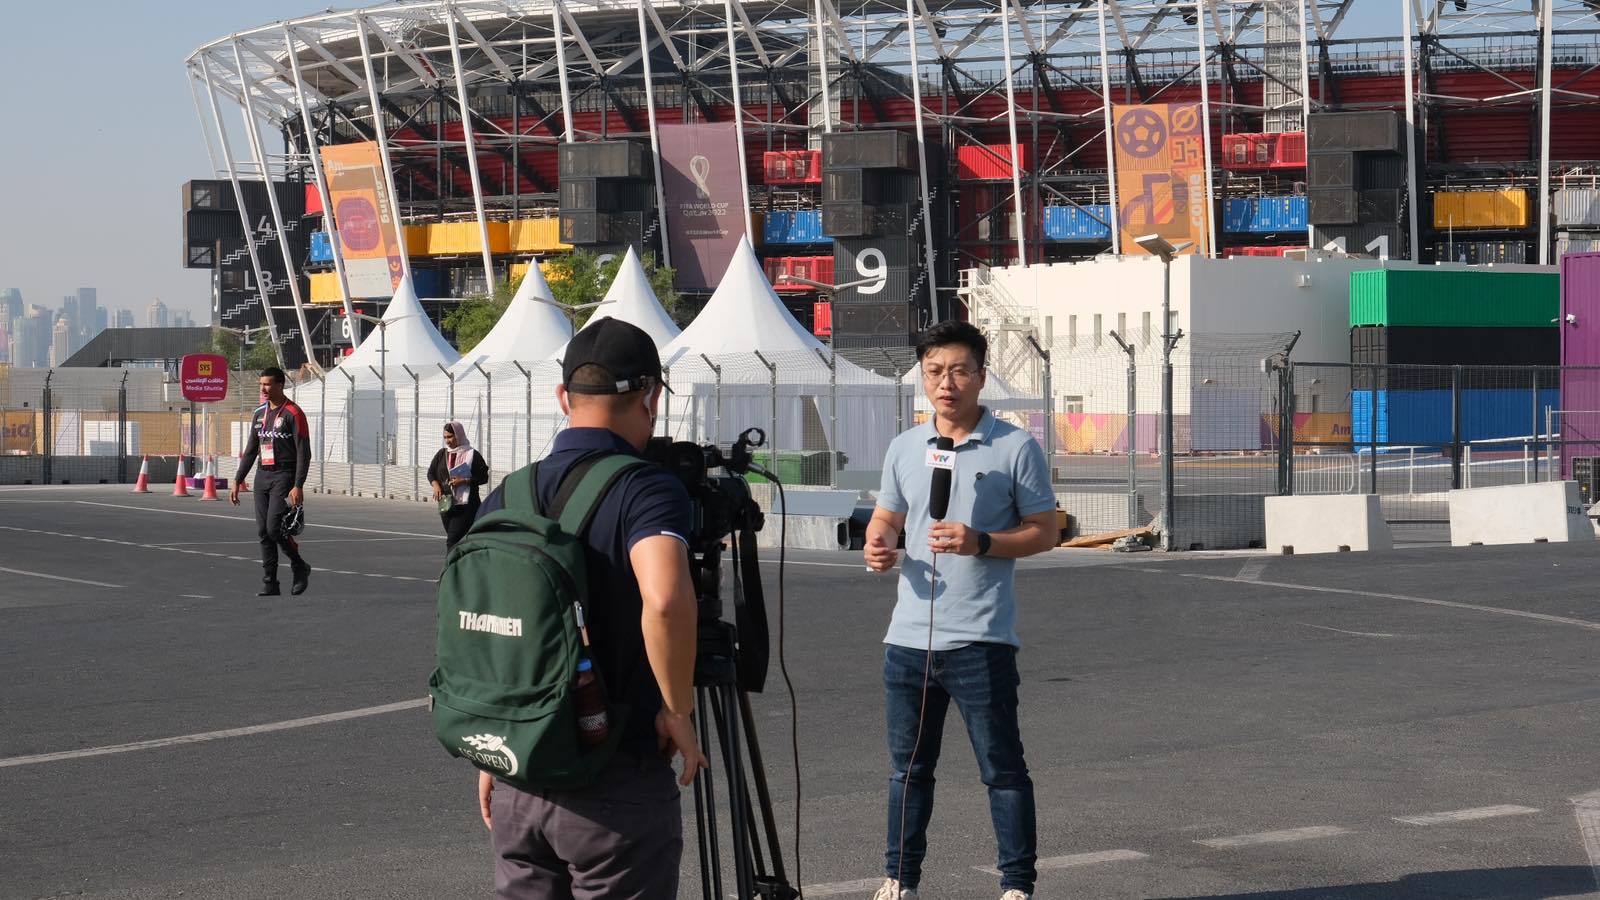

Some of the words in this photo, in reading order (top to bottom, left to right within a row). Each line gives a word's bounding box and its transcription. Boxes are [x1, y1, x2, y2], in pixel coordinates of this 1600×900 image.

[855, 248, 887, 295] 9
[342, 318, 351, 339] 6
[933, 453, 950, 462] VTV
[476, 752, 509, 771] OPEN
